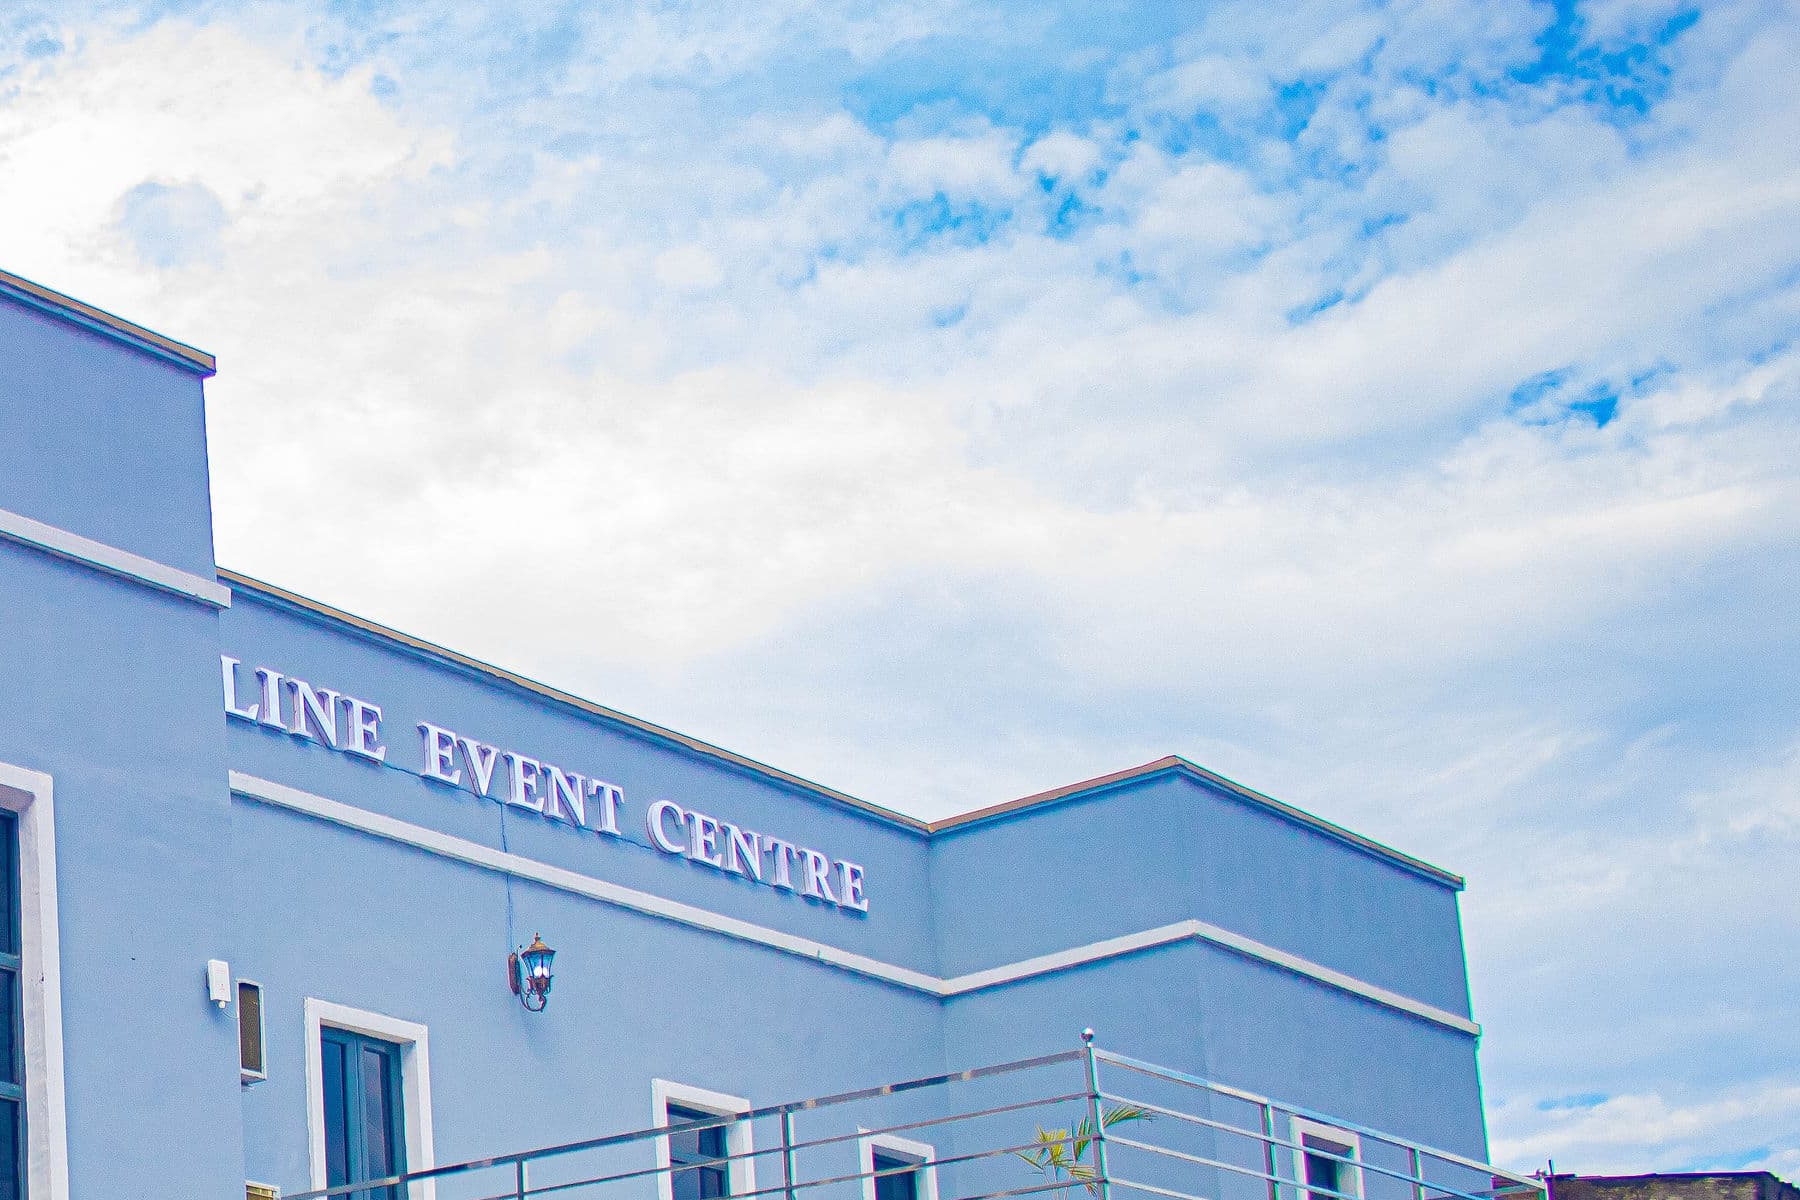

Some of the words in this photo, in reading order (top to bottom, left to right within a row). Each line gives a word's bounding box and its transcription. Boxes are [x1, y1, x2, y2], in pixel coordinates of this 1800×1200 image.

[220, 655, 386, 762] LINE
[417, 722, 624, 837] EVENT
[646, 799, 869, 912] CENTRE
